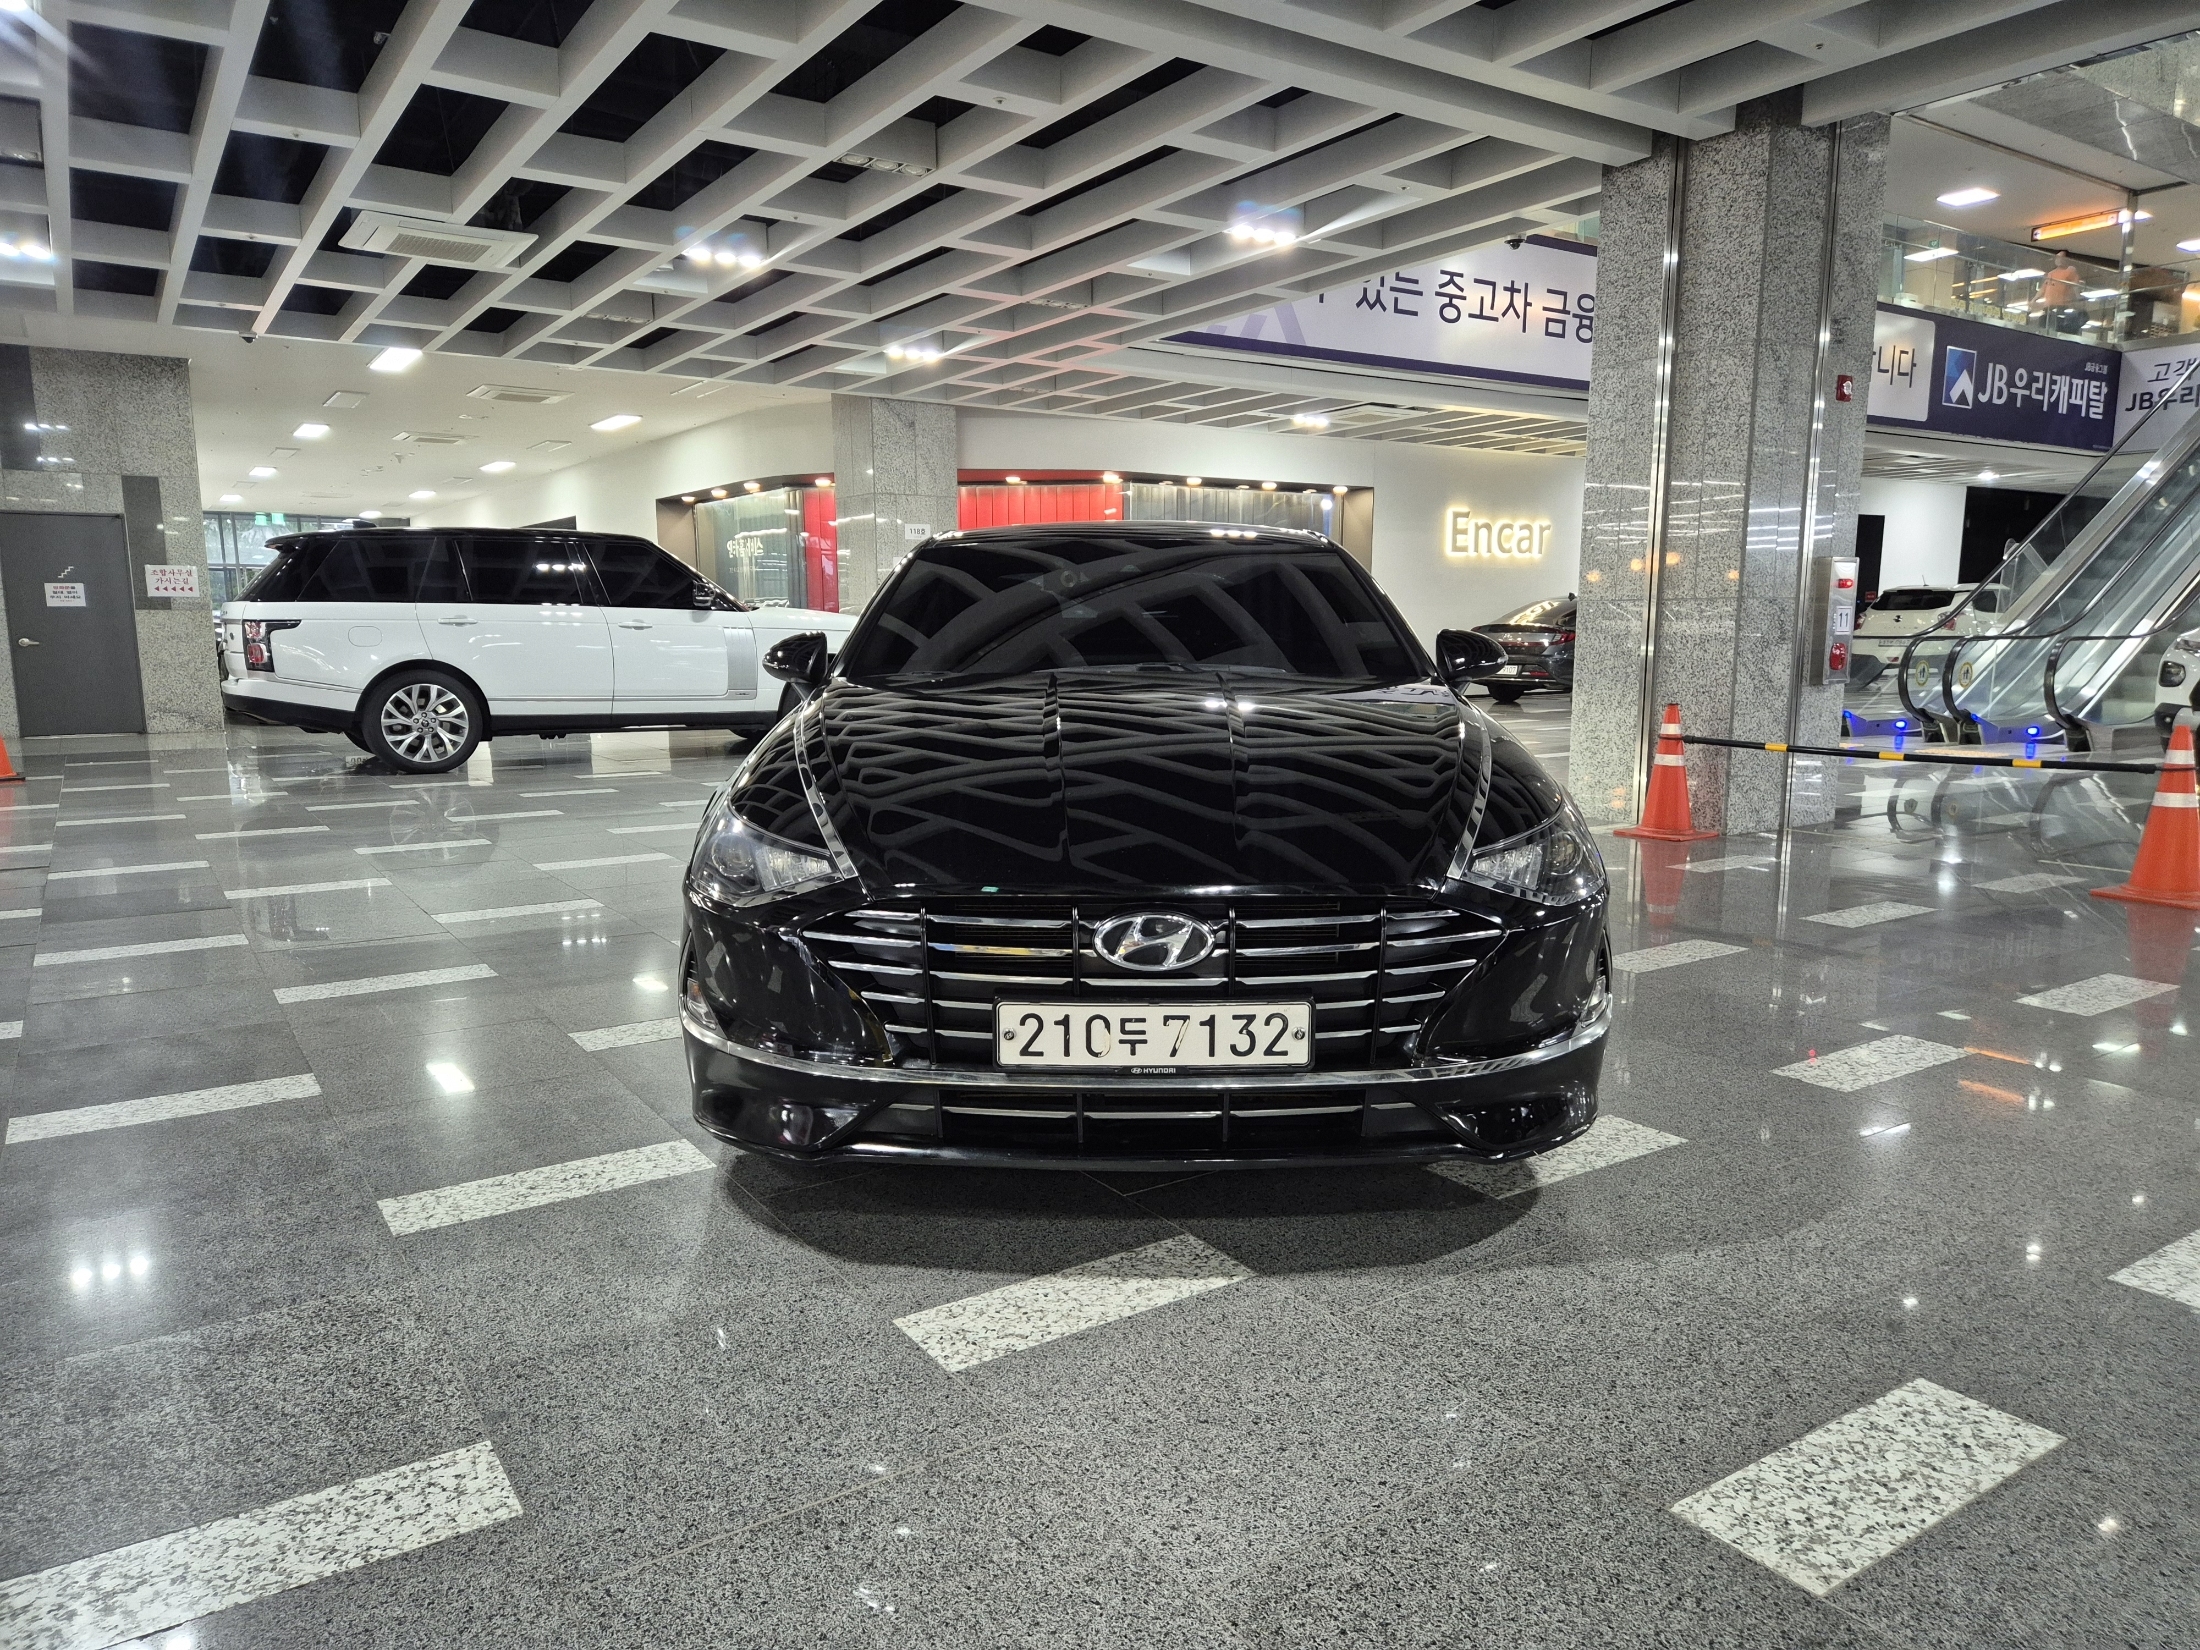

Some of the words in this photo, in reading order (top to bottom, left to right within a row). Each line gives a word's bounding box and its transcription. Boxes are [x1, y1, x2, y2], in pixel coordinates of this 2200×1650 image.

[1434, 269, 1533, 334] 중고차
[1542, 288, 1595, 344] 금융
[1872, 344, 1917, 389] 니다
[1448, 509, 1552, 557] Encar
[1839, 612, 1849, 628] 11
[1018, 1013, 1149, 1058] 210두
[1163, 1013, 1290, 1058] 7132
